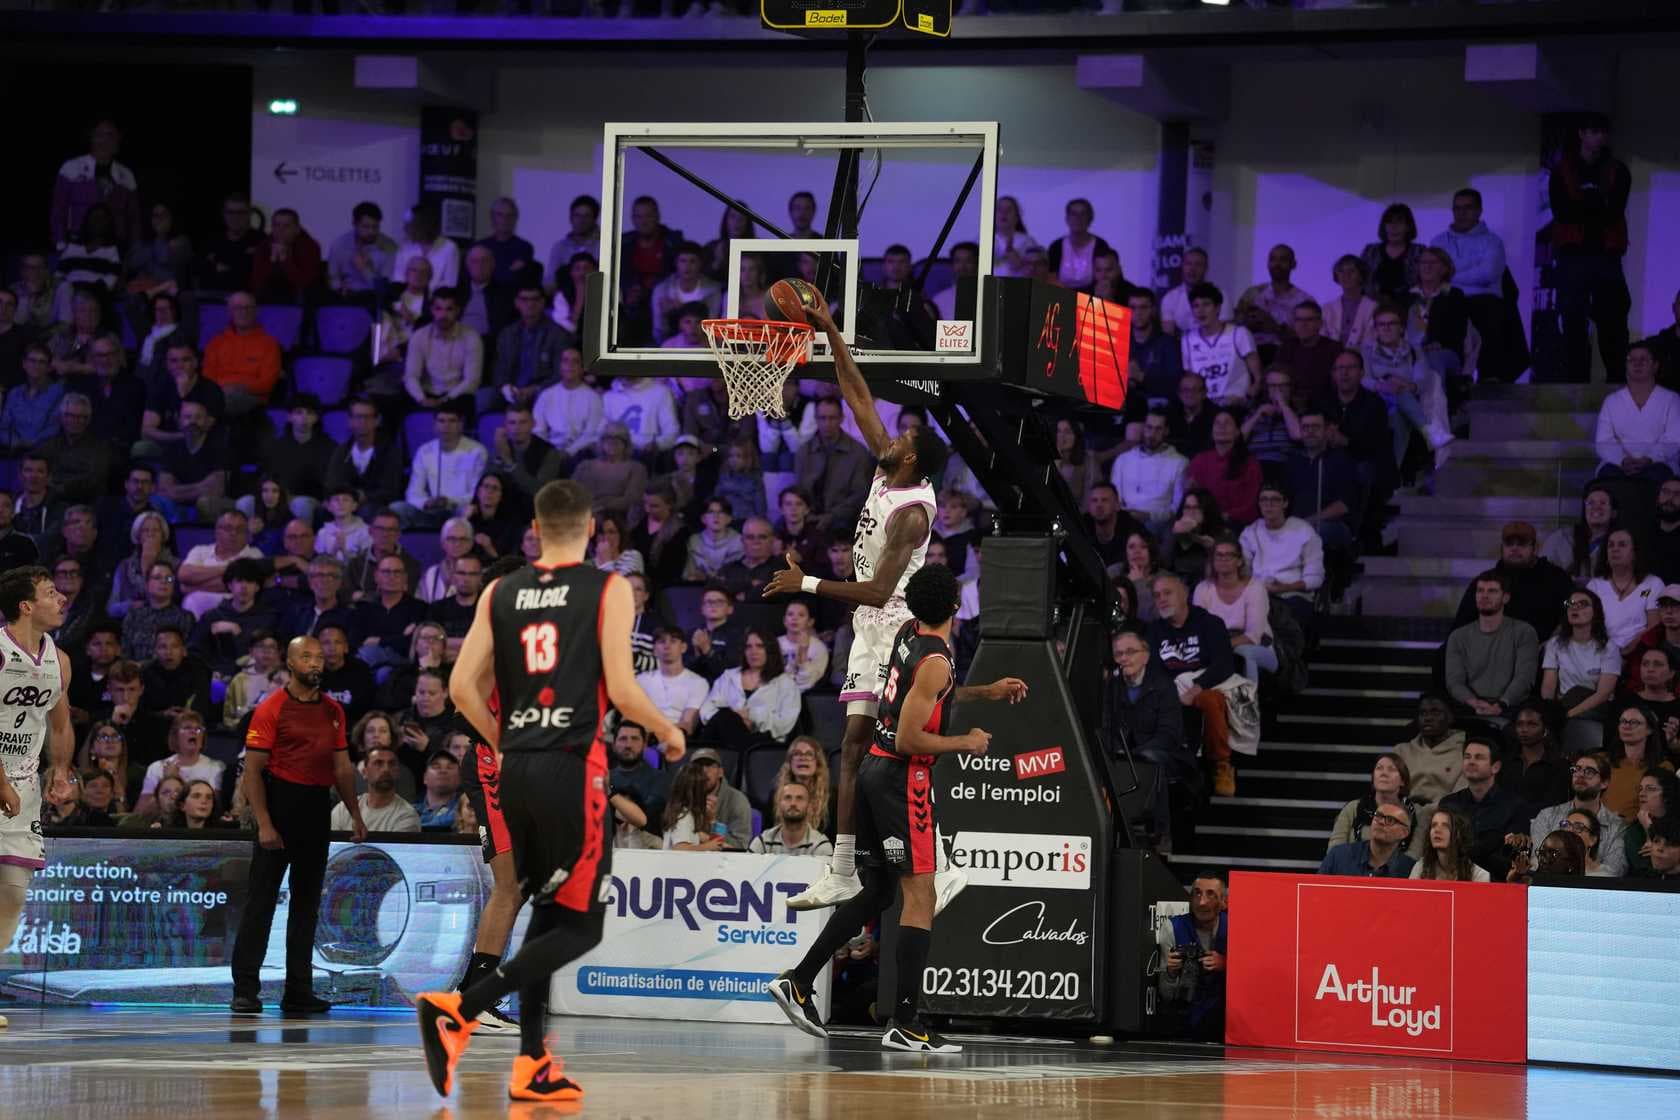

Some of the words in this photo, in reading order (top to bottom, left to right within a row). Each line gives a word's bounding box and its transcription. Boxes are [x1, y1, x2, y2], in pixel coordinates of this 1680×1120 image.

[808, 11, 845, 23] Bodet
[303, 165, 382, 184] TOILETTES
[515, 585, 570, 610] FALCOZ
[521, 621, 559, 676] 13
[3, 685, 52, 707] CBC
[508, 706, 574, 730] SPIE
[957, 753, 1012, 772] Votre
[1017, 751, 1062, 775] MVP
[950, 782, 976, 800] de
[981, 783, 1061, 806] l'emploi
[33, 860, 139, 882] nstruction,
[25, 883, 86, 903] enaire
[91, 884, 104, 903] à
[109, 887, 161, 904] votre
[166, 885, 228, 910] image
[606, 876, 809, 931] AURENT
[717, 924, 798, 945] Services
[982, 900, 1089, 945] Calvados
[587, 970, 683, 991] Climatisation
[687, 973, 704, 991] de
[709, 975, 769, 994] véhicule
[922, 966, 1080, 1001] 02.31.34.20.20
[1314, 963, 1417, 1006] Arthur
[1371, 1002, 1441, 1037] Loyd
